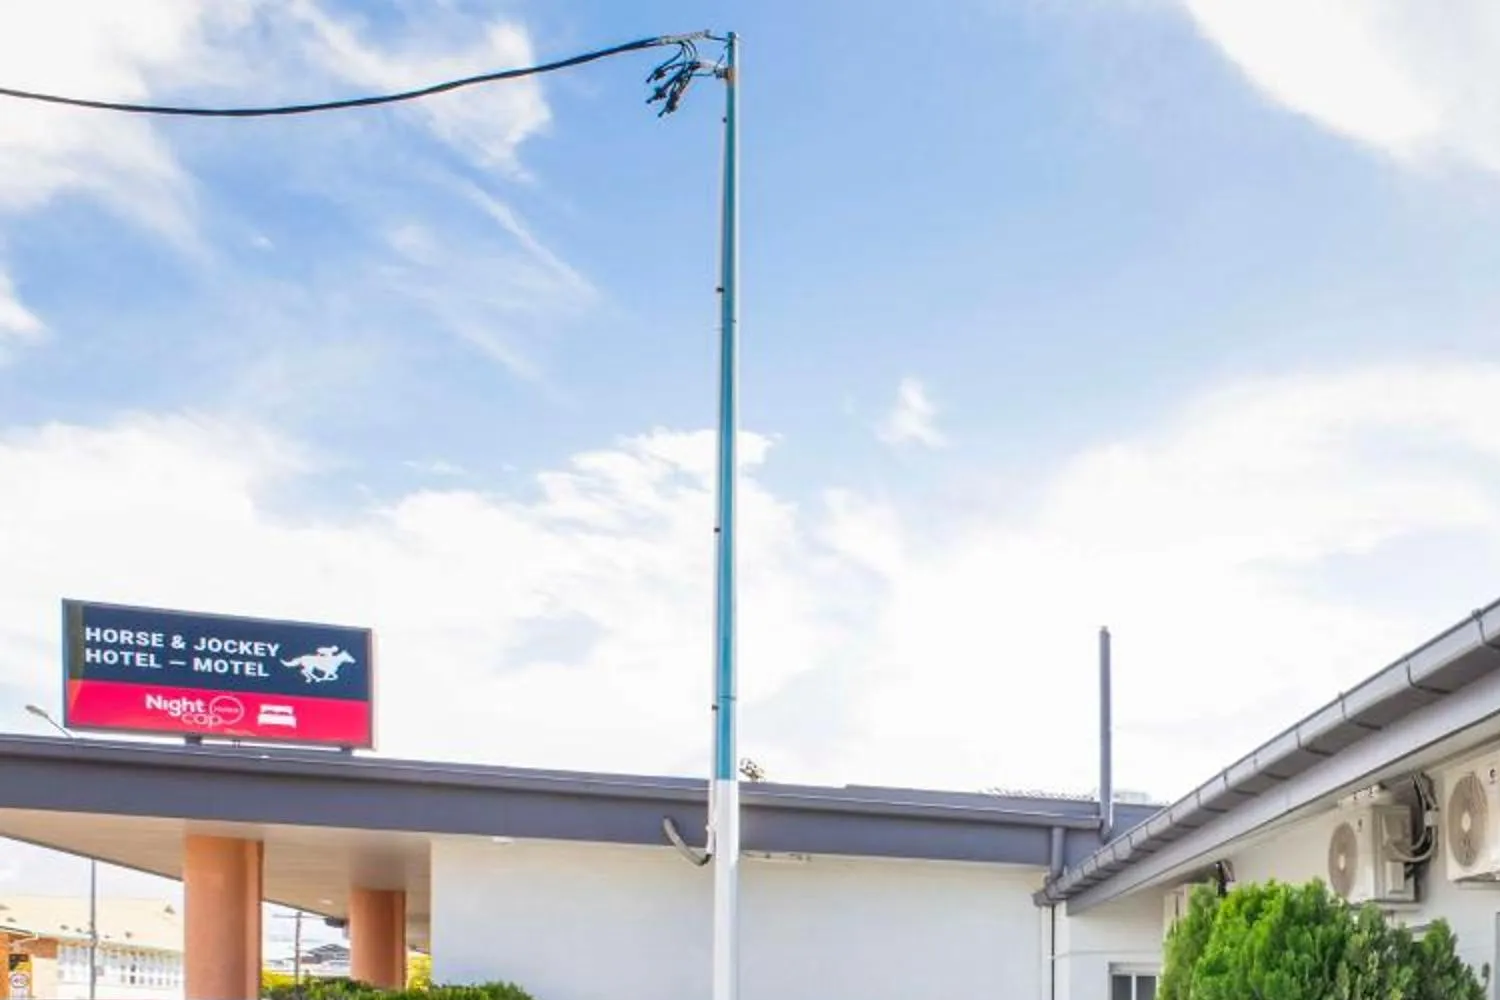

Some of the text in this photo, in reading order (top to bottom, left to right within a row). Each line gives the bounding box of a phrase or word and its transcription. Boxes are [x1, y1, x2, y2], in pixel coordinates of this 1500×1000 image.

[85, 627, 280, 657] HORSE & JOCKEY
[85, 648, 162, 669] HOTEL
[193, 657, 270, 677] MOTEL
[145, 693, 205, 717] Night
